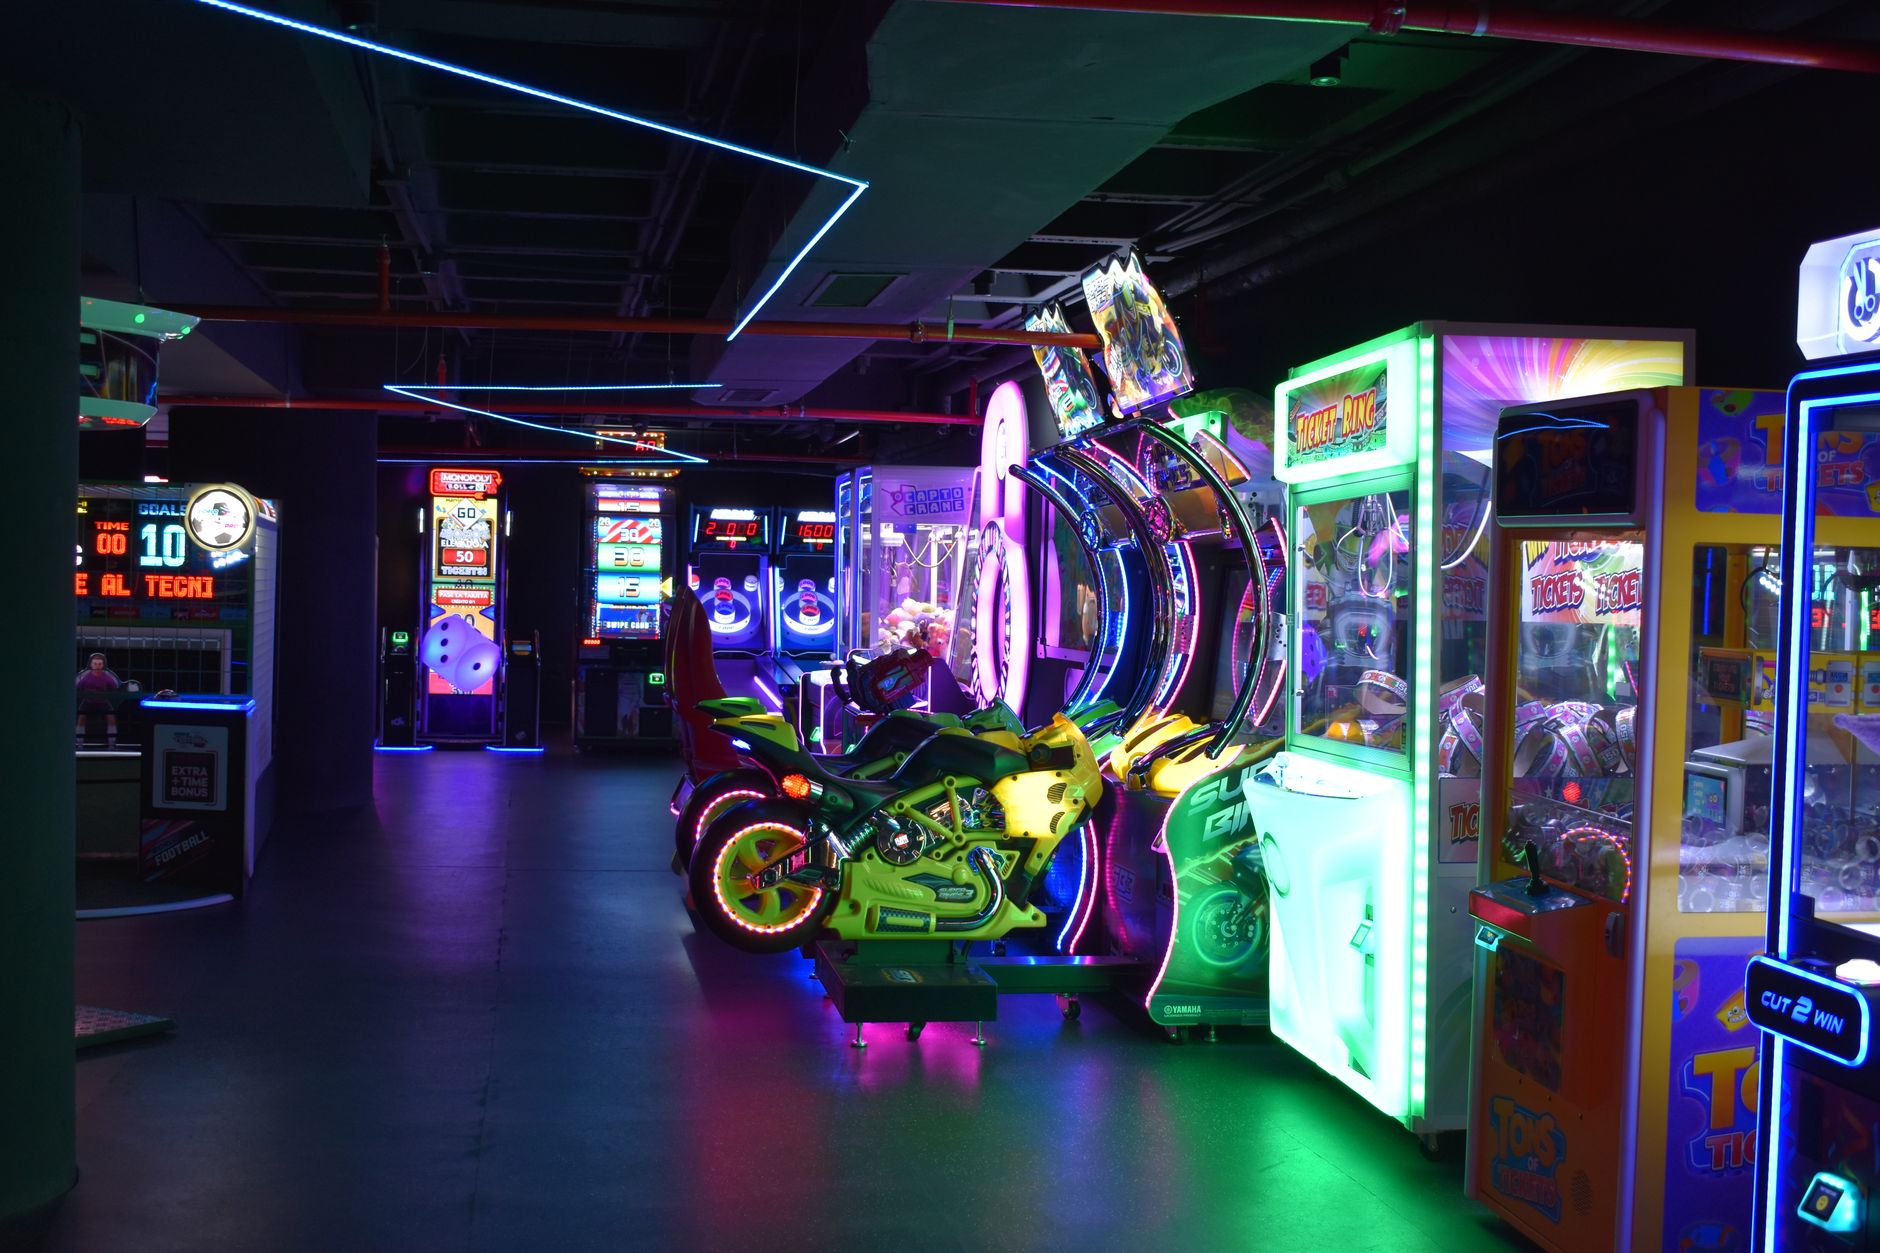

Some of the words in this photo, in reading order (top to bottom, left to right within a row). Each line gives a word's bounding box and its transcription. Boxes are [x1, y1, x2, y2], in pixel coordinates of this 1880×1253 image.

[1296, 402, 1338, 453] TICKET
[1342, 388, 1377, 438] RING
[1818, 450, 1836, 462] OF
[442, 473, 490, 482] MONOPOLY
[138, 503, 186, 515] GOALS
[457, 507, 476, 519] GO
[905, 500, 965, 515] CRANE
[95, 521, 129, 530] TIME
[799, 524, 834, 538] 1600
[96, 533, 127, 555] 00
[140, 524, 186, 567] 10
[456, 550, 474, 563] 50
[614, 547, 644, 567] 30
[101, 574, 131, 597] AL
[145, 575, 214, 599] TECNI
[617, 577, 640, 597] 15
[1530, 569, 1585, 613] TICKETS
[606, 621, 629, 629] SWIPE
[171, 765, 208, 777] EXTRA
[171, 786, 208, 797] BONUS
[154, 829, 209, 866] FOOTBALL
[1173, 1005, 1201, 1014] YAMAHA
[1761, 991, 1789, 1014] CUT
[1791, 996, 1813, 1024] 2
[1814, 1008, 1844, 1035] WIN
[1528, 1157, 1539, 1169] OF
